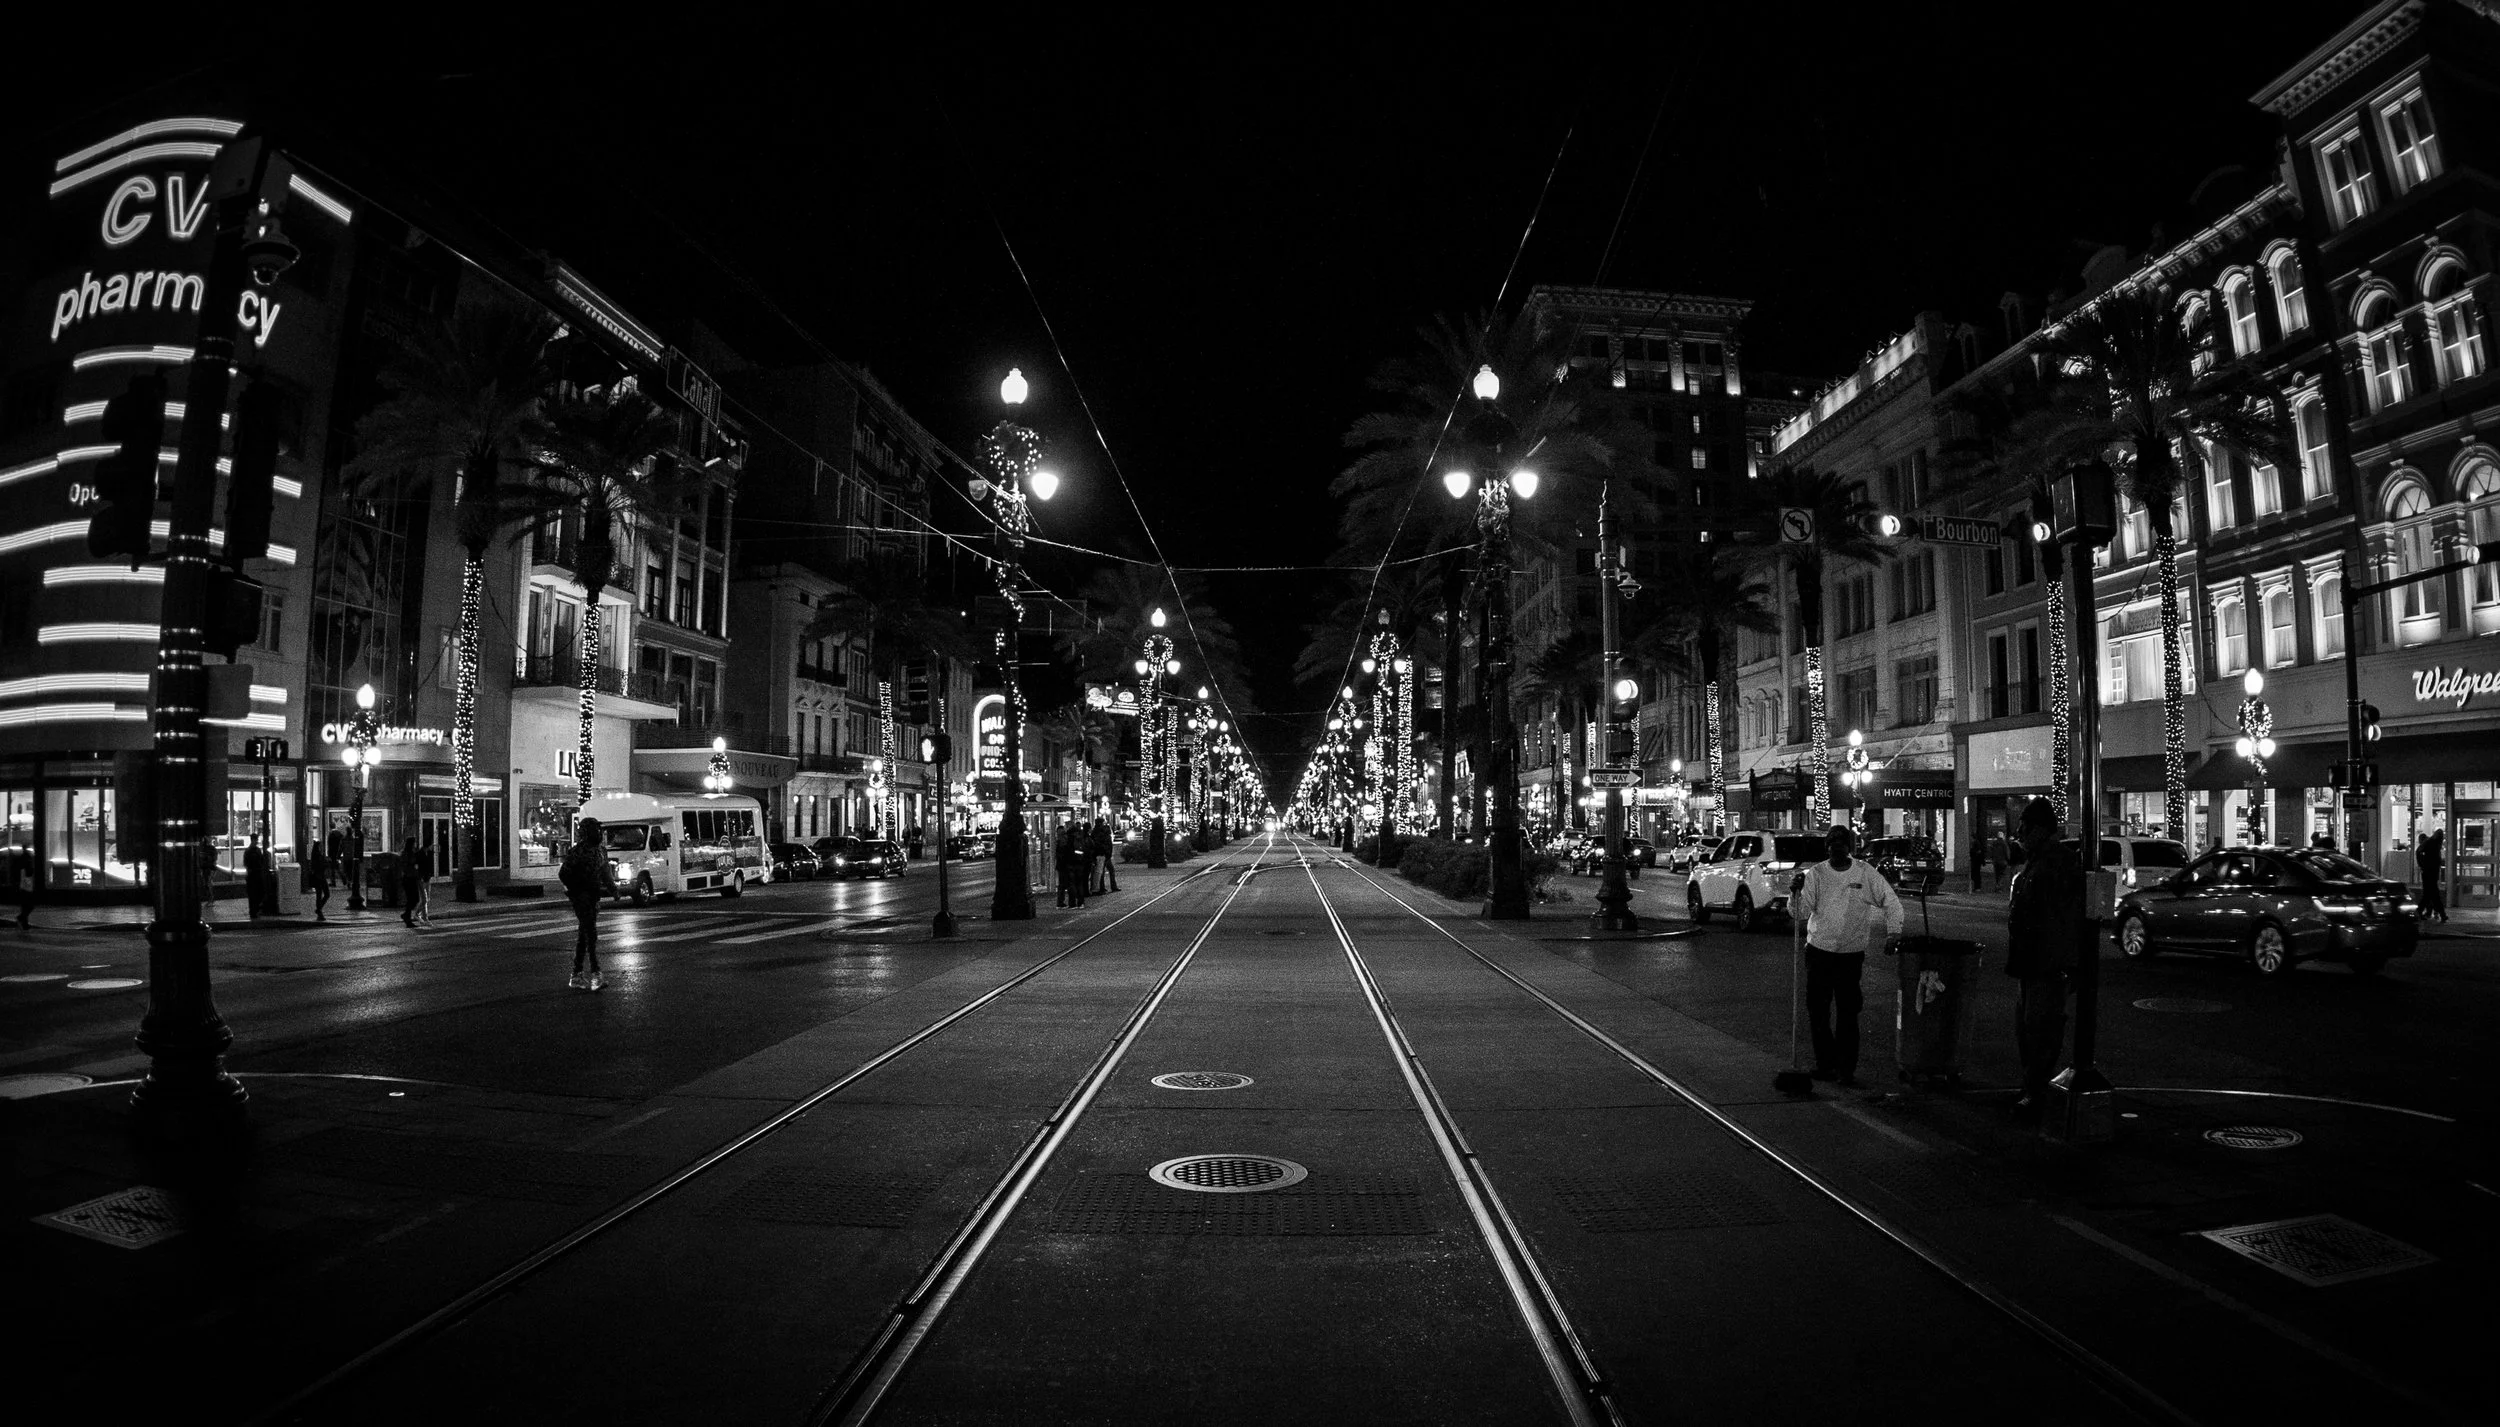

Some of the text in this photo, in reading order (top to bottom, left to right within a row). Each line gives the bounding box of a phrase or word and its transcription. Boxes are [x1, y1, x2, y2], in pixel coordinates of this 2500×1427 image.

[100, 172, 212, 248] CV
[51, 270, 281, 348] pharmcy
[1936, 517, 1998, 544] Bourbon
[1595, 774, 1629, 783] ONE WAY
[1884, 788, 1953, 799] HYATT CENTRIC
